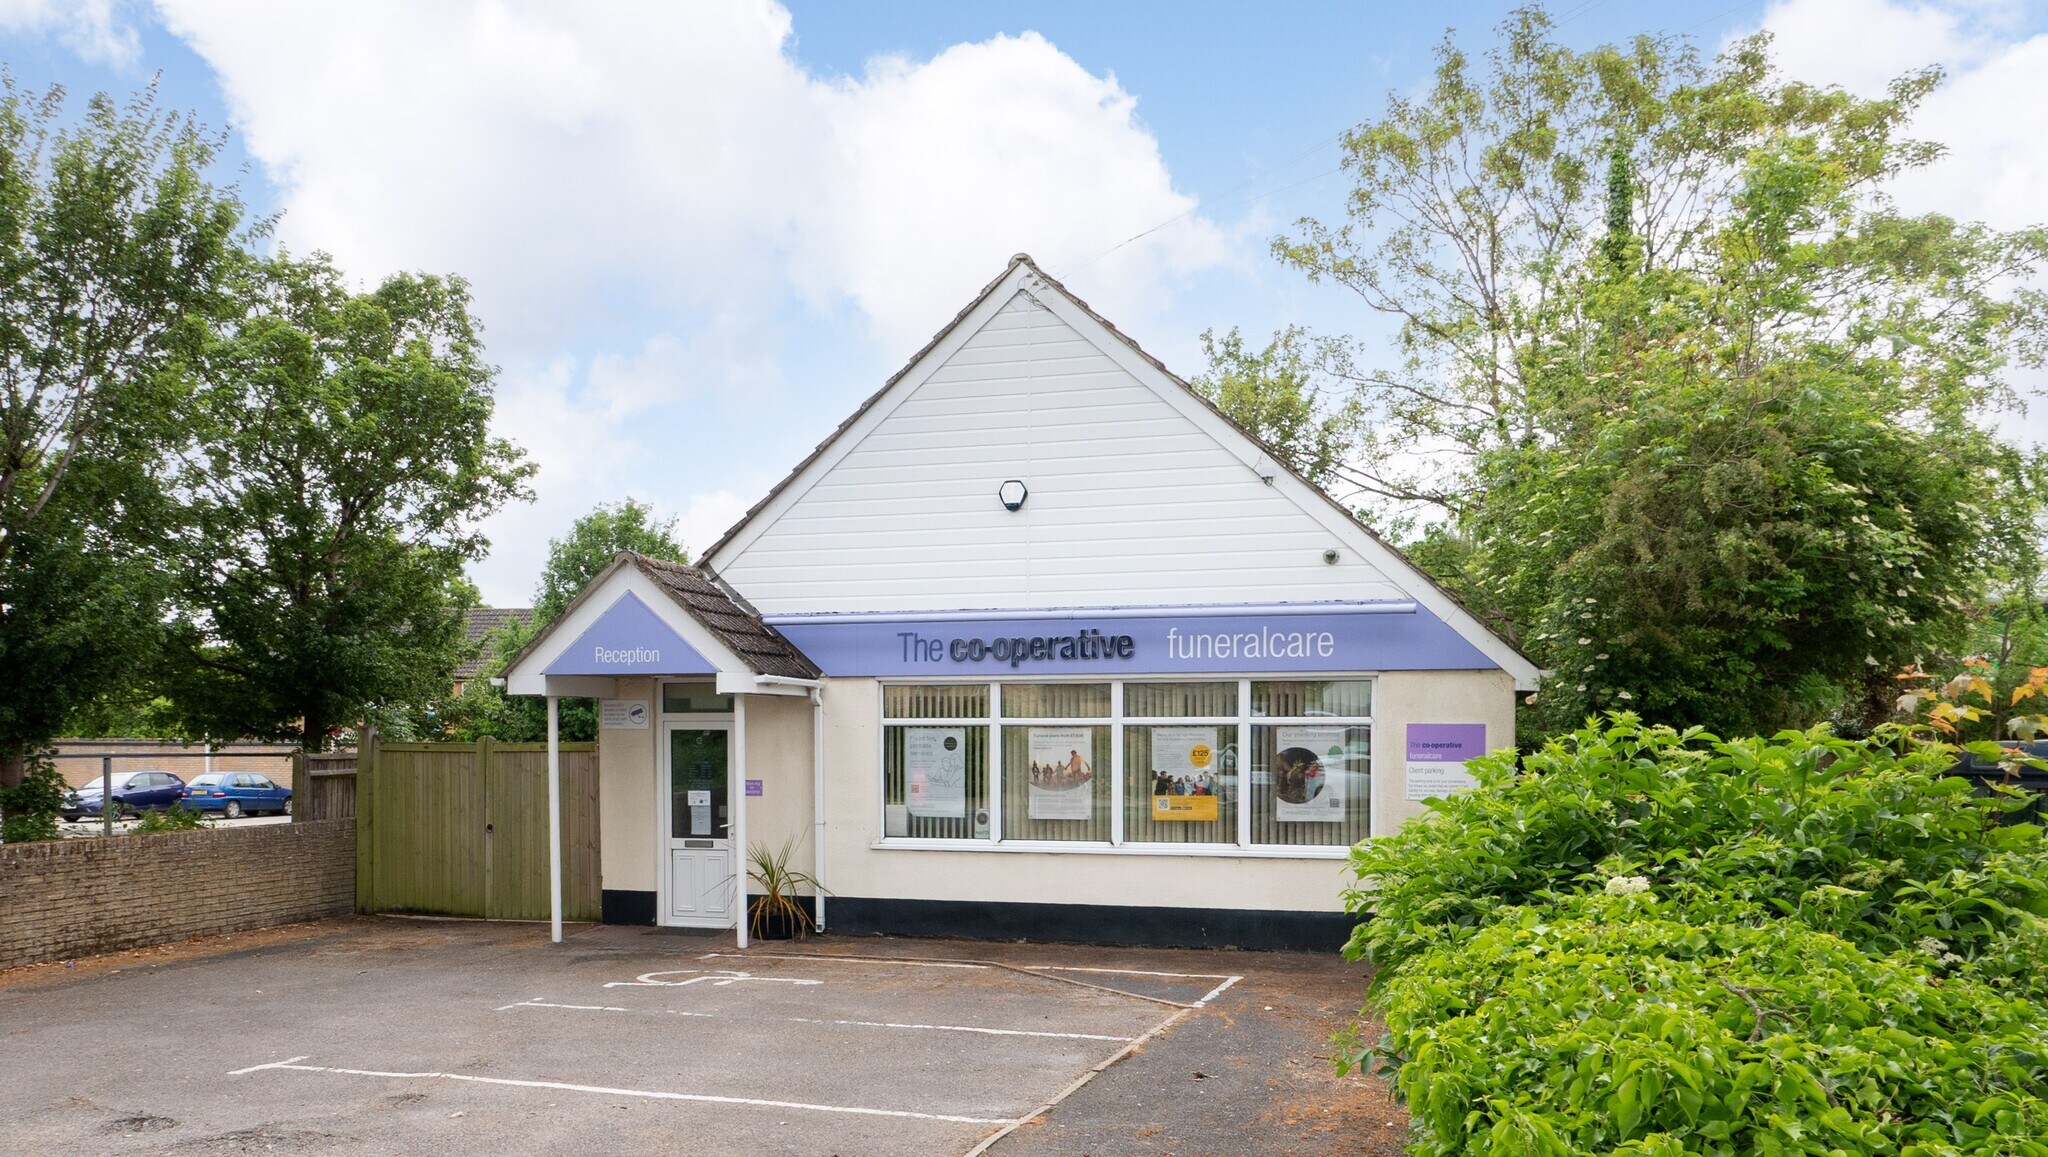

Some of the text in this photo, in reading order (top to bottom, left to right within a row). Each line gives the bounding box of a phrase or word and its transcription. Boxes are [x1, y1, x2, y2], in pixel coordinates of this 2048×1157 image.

[595, 646, 660, 666] Reception
[897, 626, 1334, 668] The co-operative funeralcare
[1192, 749, 1210, 757] £125
